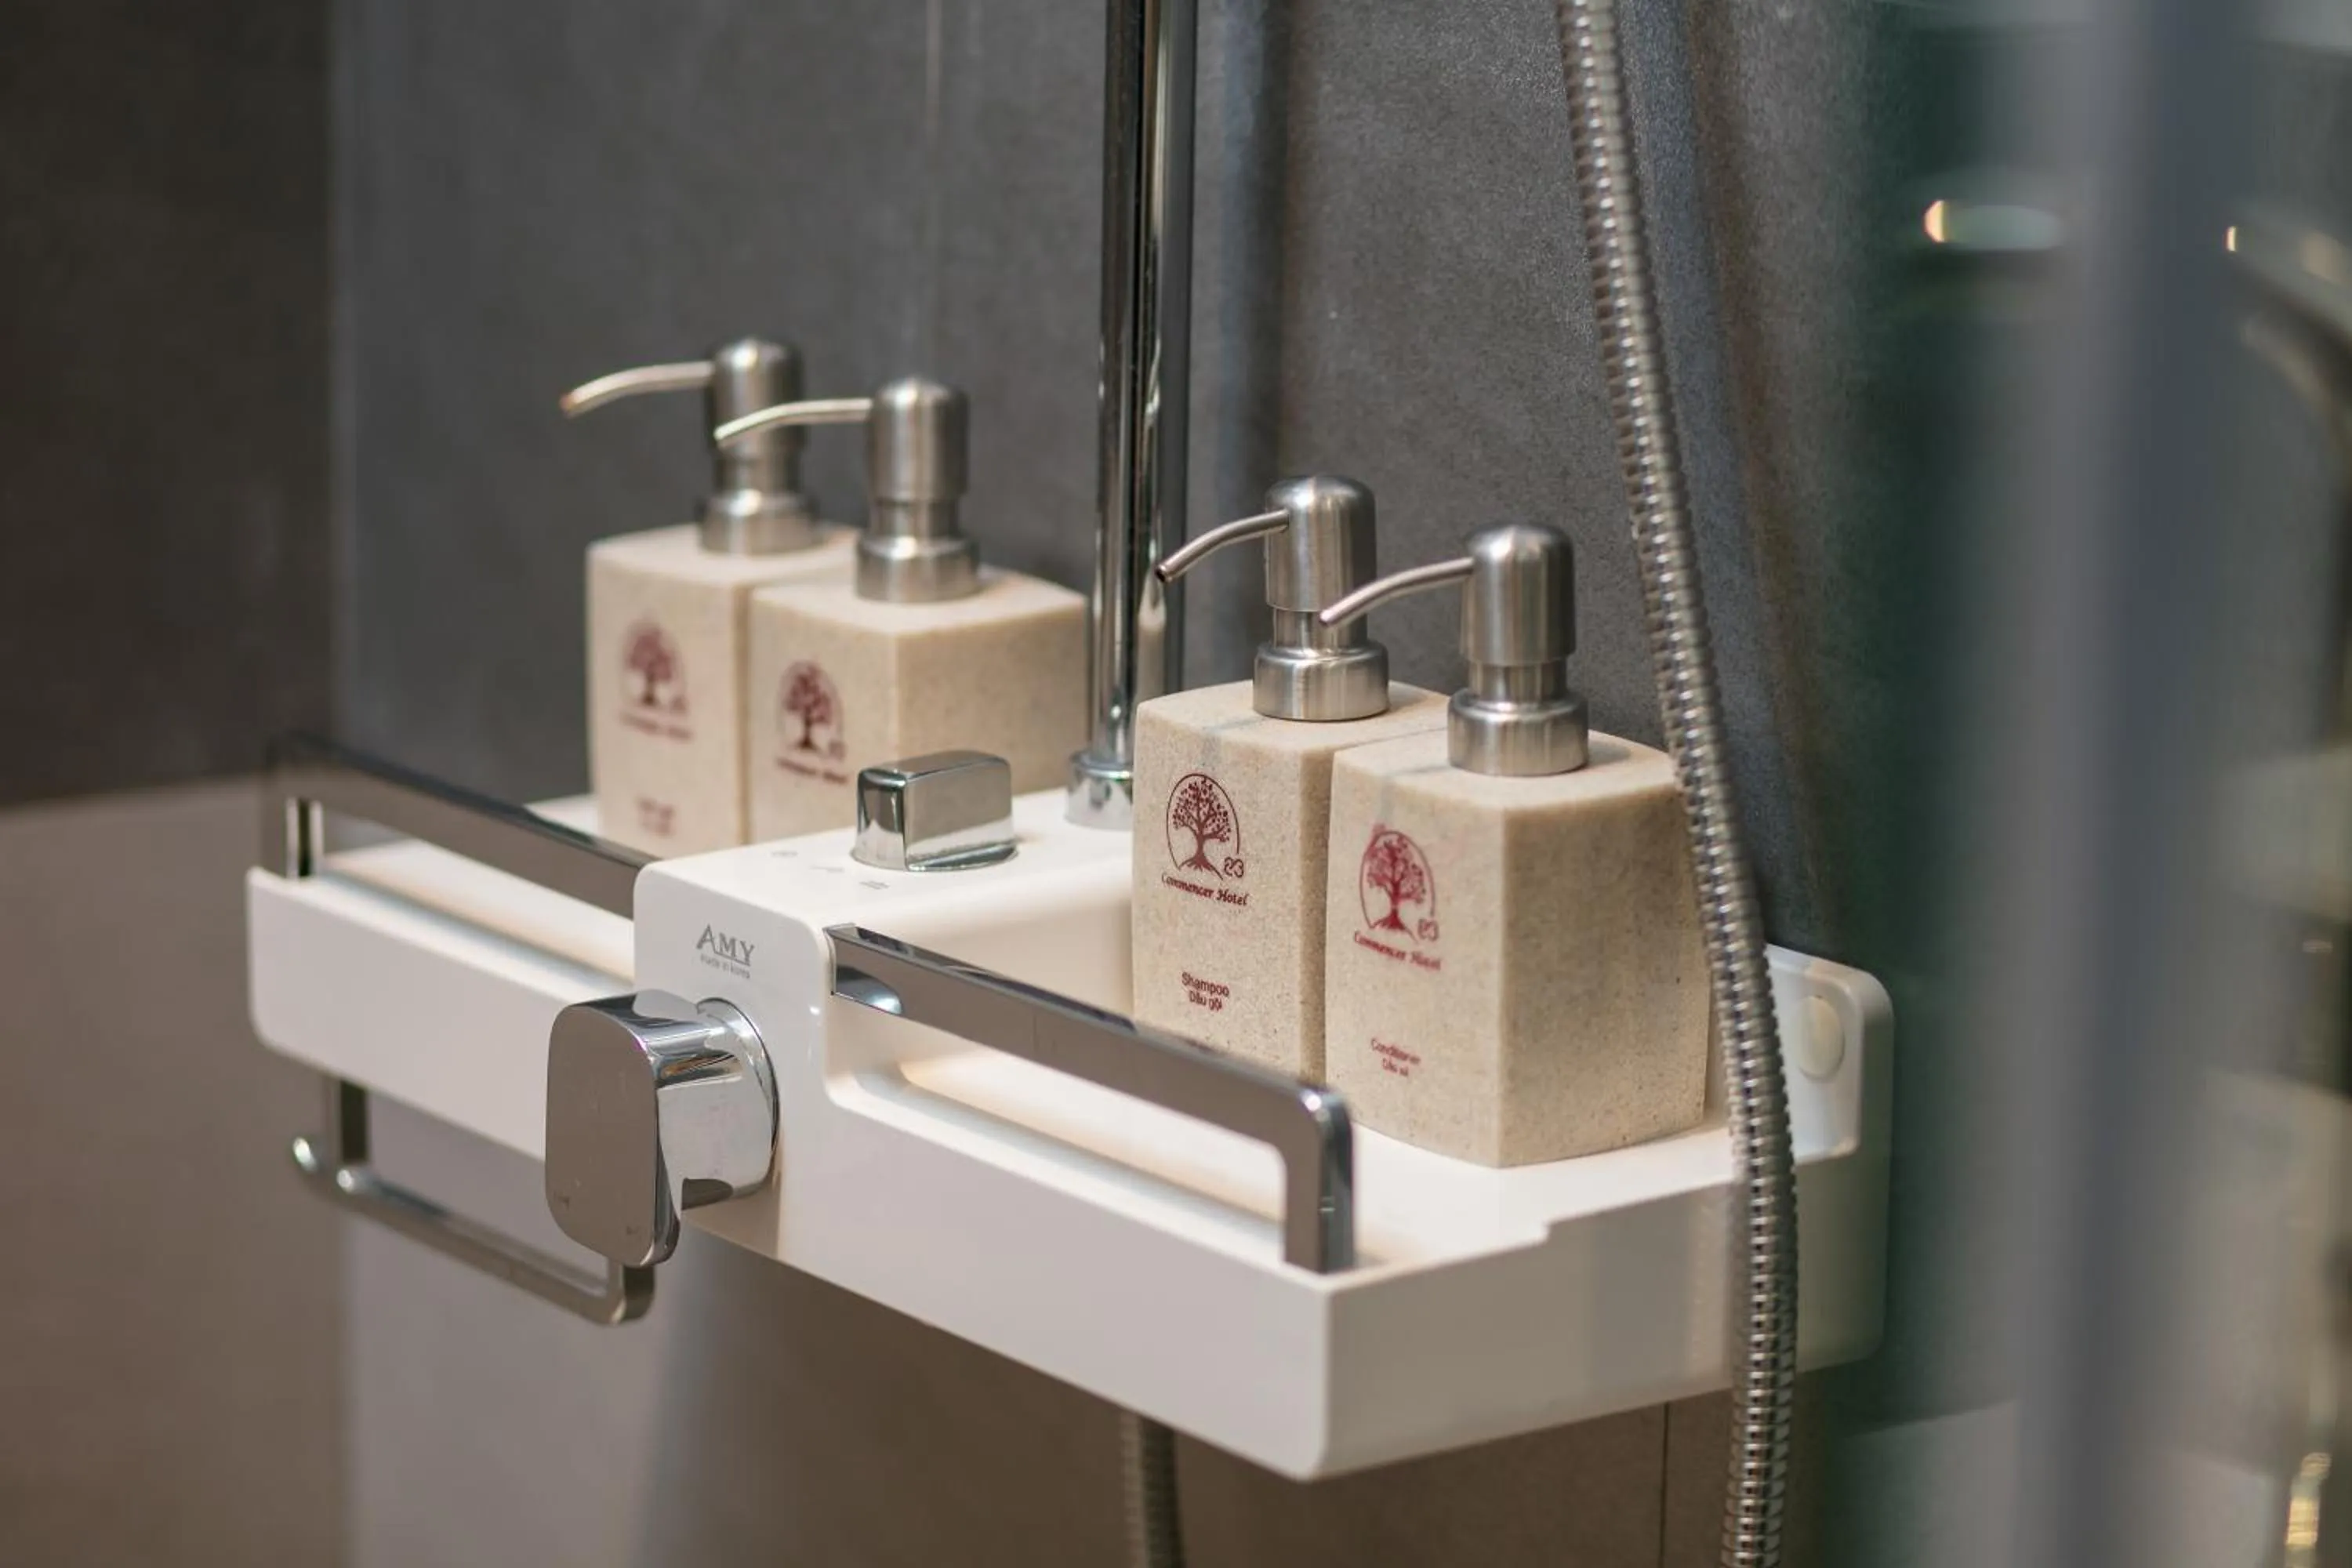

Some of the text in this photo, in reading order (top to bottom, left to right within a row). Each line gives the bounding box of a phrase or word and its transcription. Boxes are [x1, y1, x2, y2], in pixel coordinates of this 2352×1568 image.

[1216, 887, 1248, 906] Hotel
[696, 923, 755, 967] AMY
[1181, 971, 1230, 998] Shampoo
